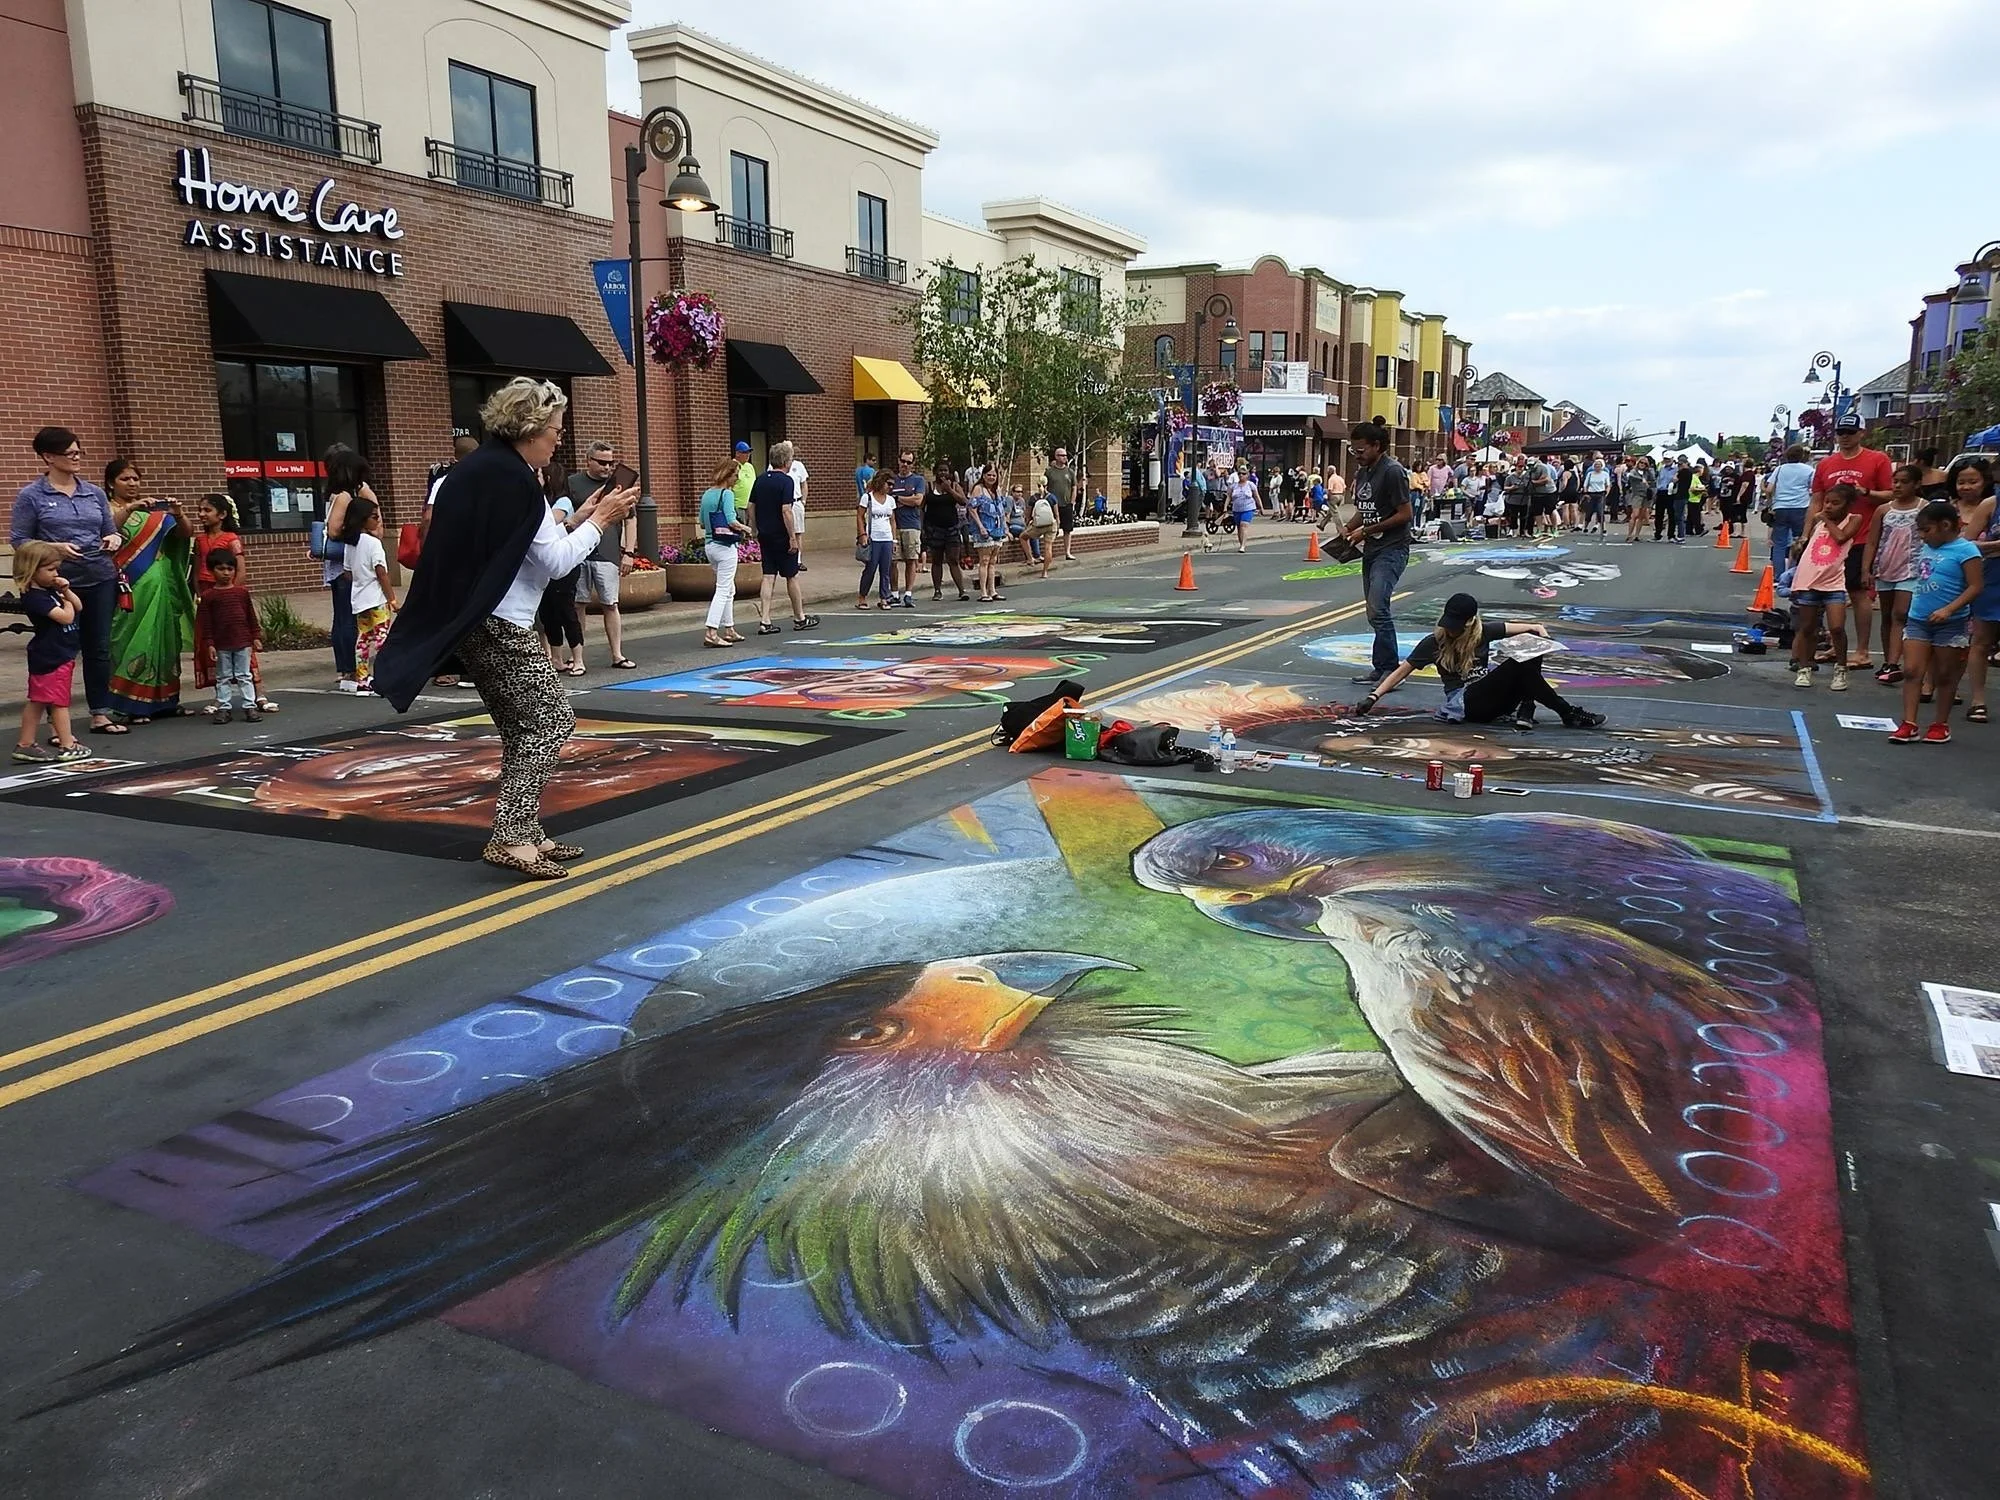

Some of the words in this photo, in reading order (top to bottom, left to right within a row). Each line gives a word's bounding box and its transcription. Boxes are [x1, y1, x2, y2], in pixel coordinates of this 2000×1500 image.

[178, 147, 307, 223] Home
[314, 178, 404, 240] Care
[189, 220, 404, 276] ASSISTANCE
[1245, 429, 1258, 437] ELM
[1259, 429, 1279, 437] CREEK
[235, 465, 260, 473] Seniors
[275, 465, 289, 473] Live
[290, 465, 305, 473] Well
